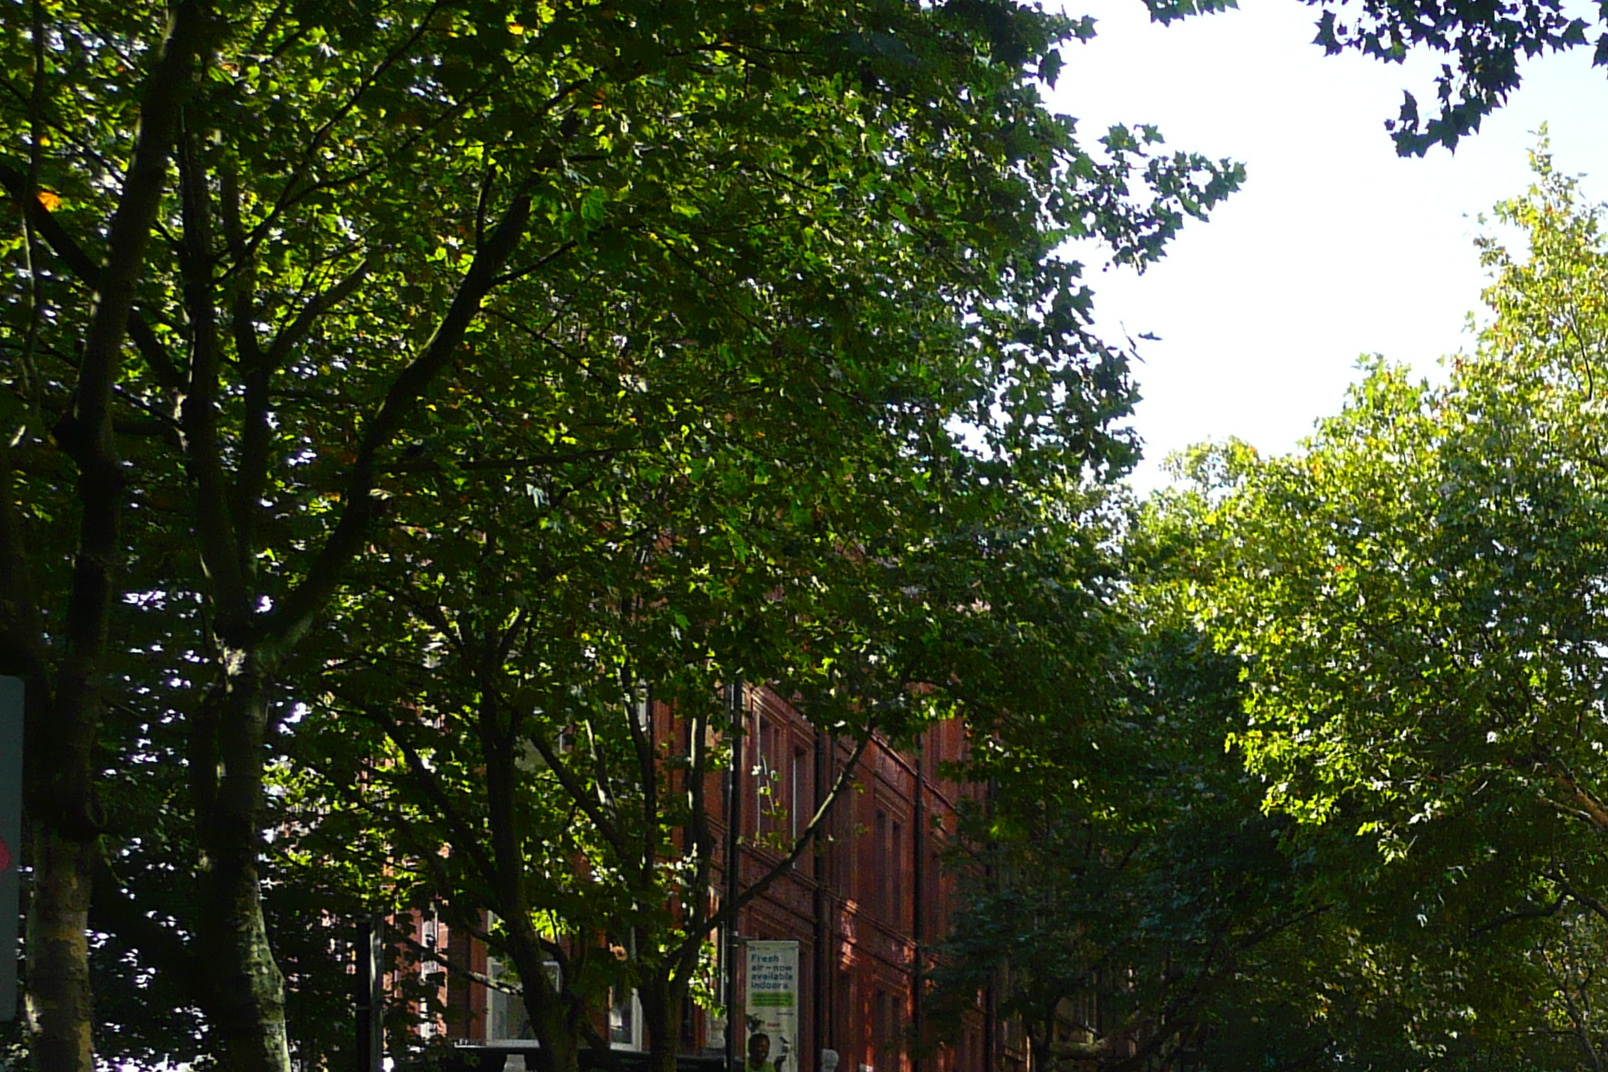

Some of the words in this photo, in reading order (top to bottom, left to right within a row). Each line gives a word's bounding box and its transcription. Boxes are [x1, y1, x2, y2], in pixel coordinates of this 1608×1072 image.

[752, 954, 779, 962] Fresh
[751, 973, 793, 981] available
[751, 981, 789, 989] indoors
